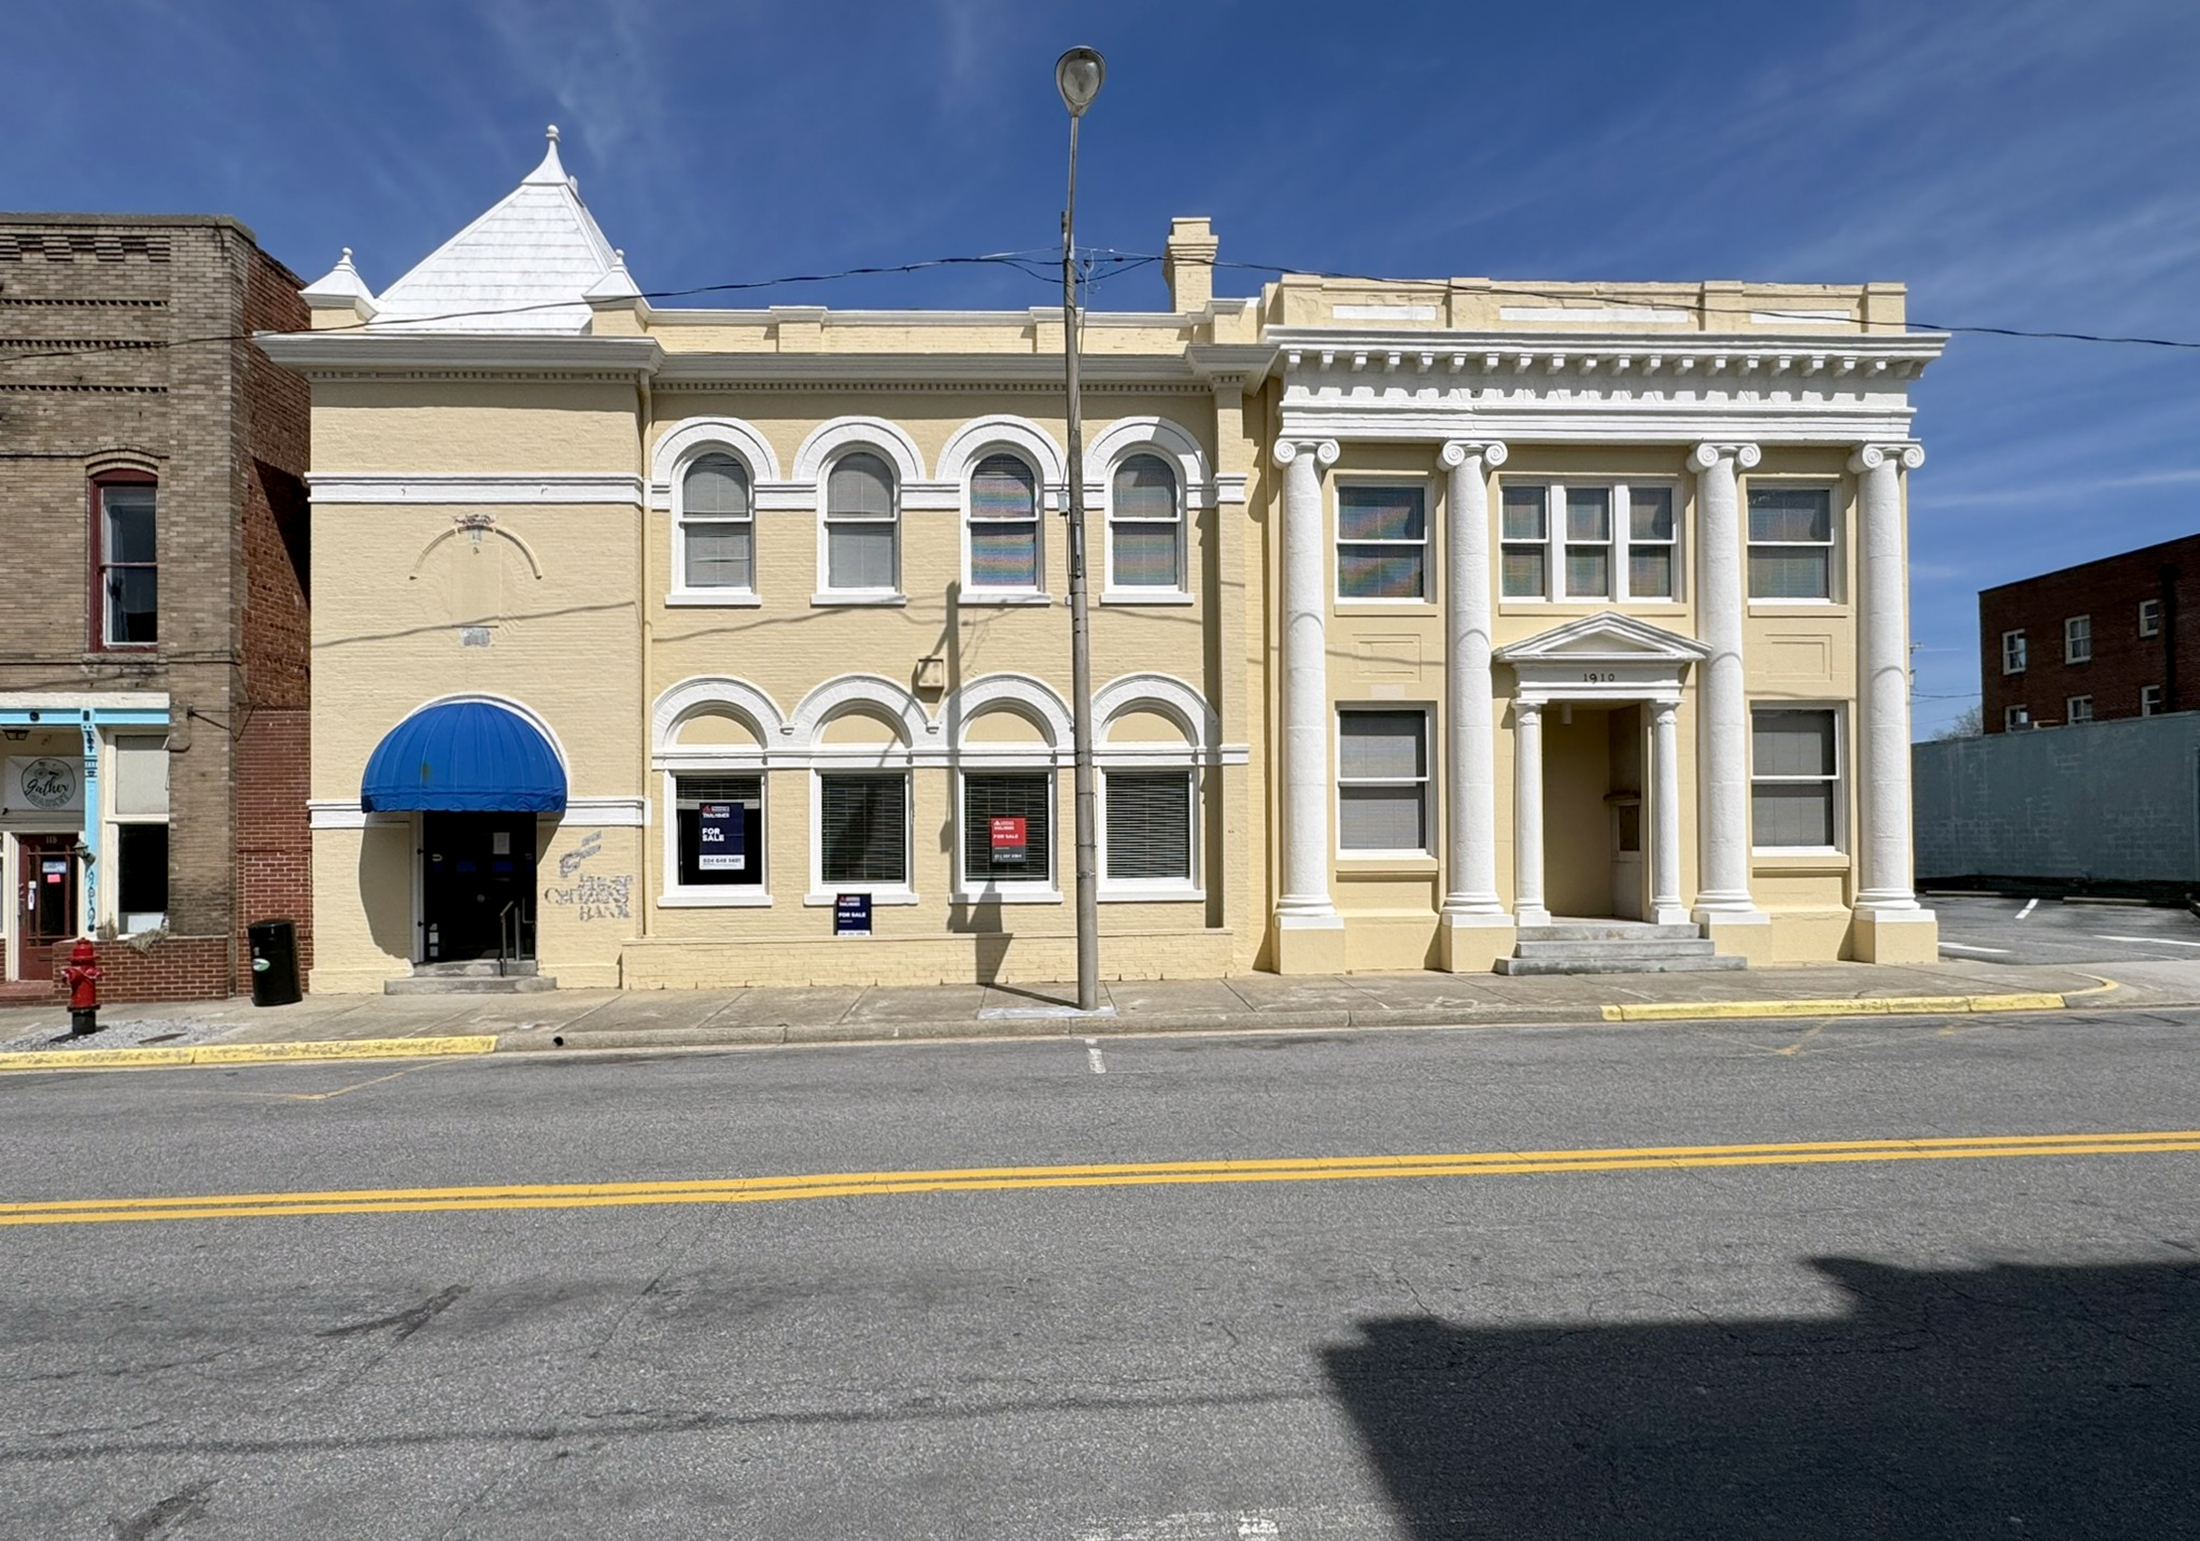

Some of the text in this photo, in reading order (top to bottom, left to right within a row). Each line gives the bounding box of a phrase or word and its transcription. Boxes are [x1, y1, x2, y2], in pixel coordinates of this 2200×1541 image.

[1583, 673, 1615, 684] 1910
[702, 827, 721, 835] FOR
[702, 834, 725, 842] SALE
